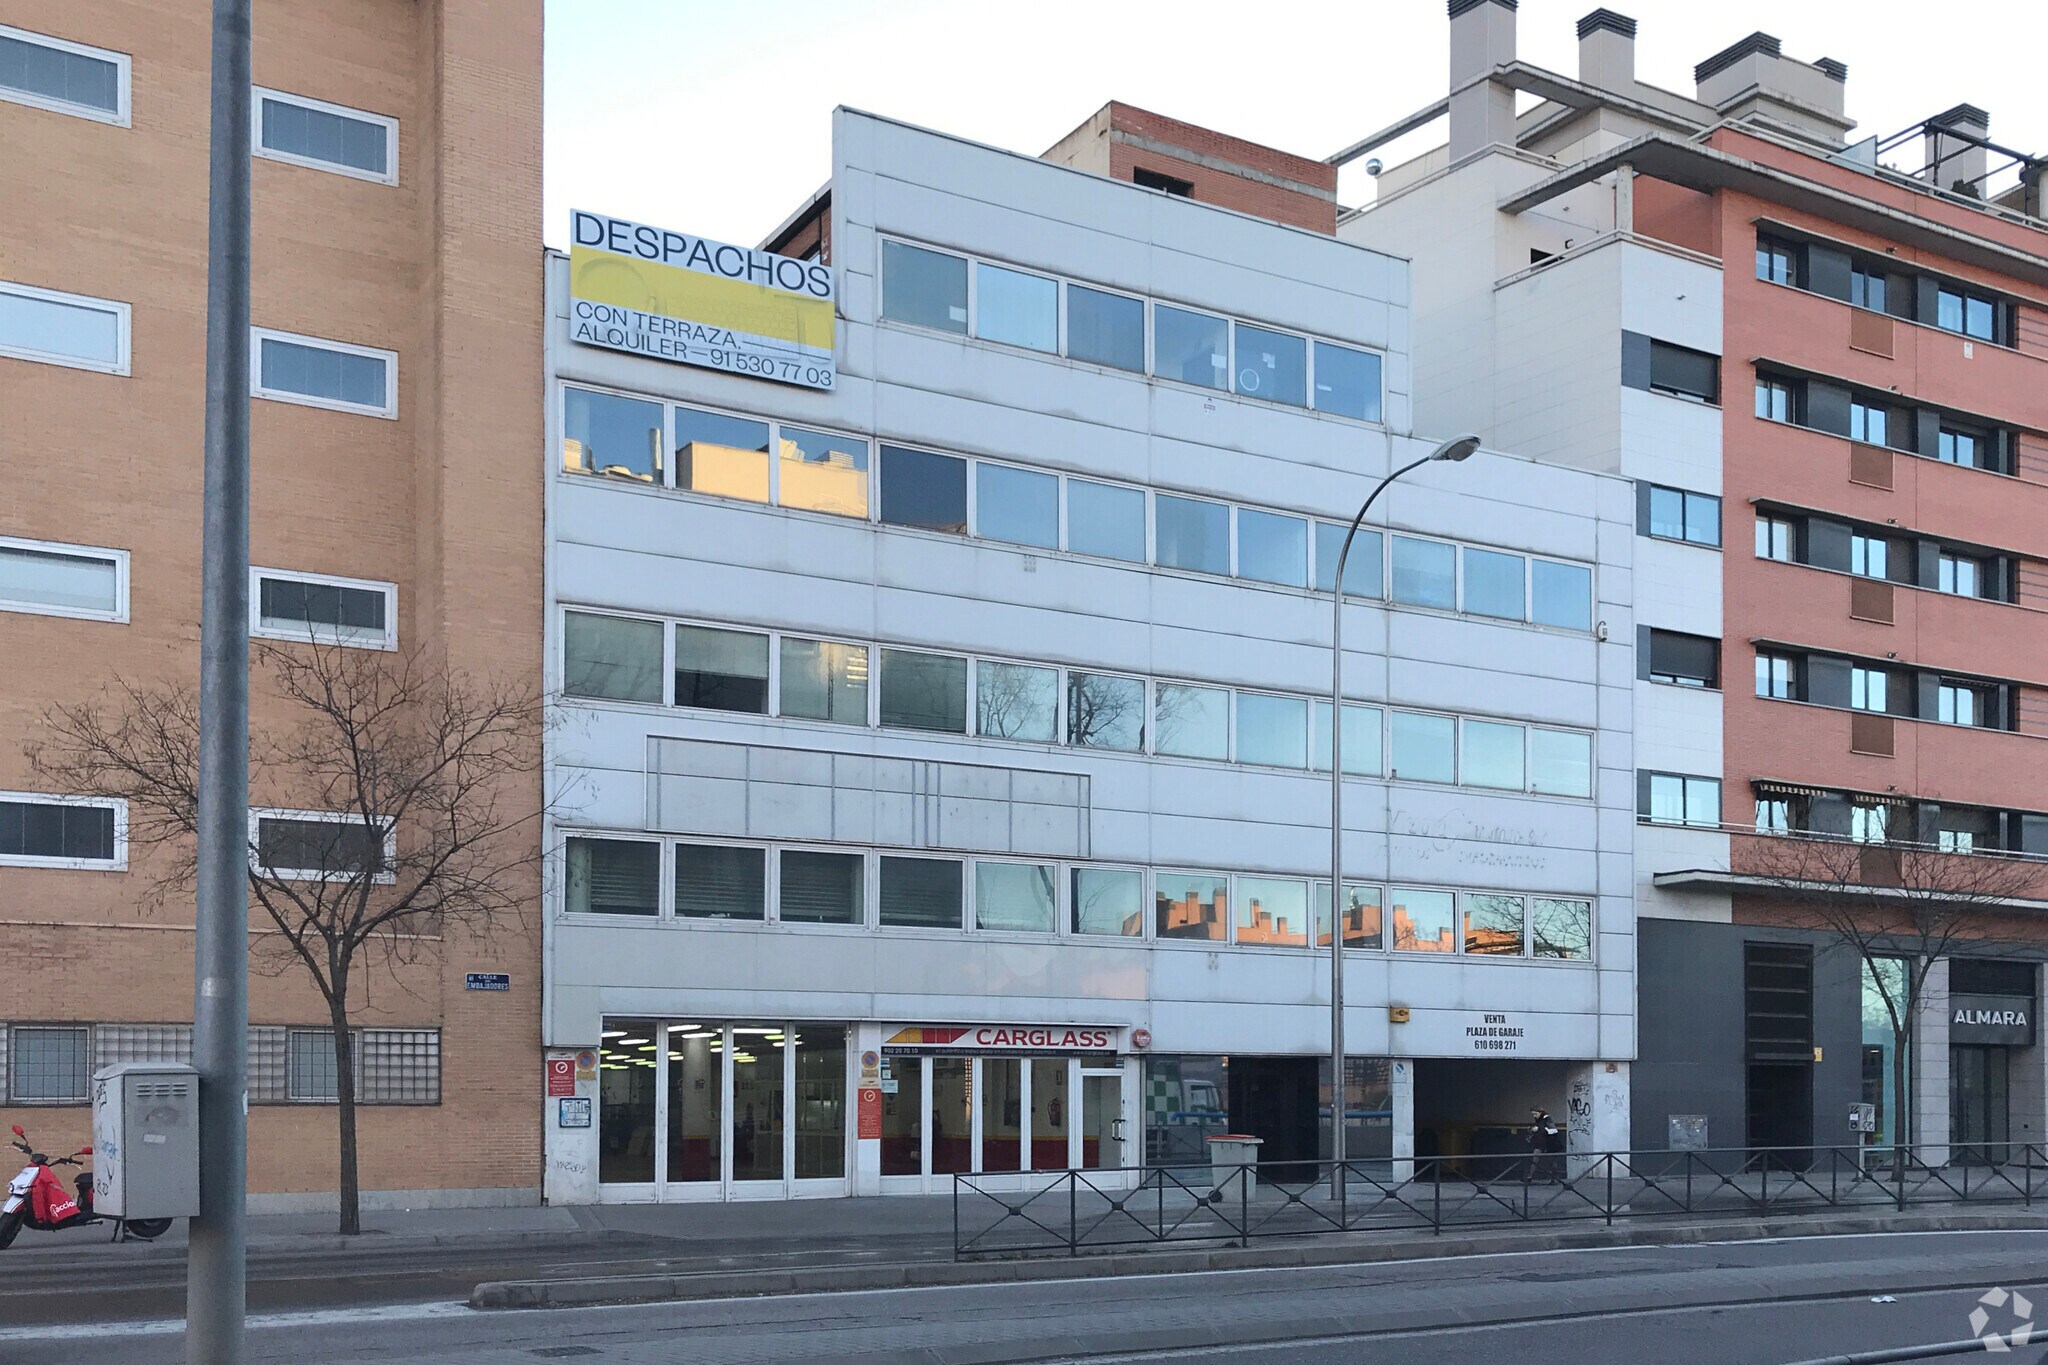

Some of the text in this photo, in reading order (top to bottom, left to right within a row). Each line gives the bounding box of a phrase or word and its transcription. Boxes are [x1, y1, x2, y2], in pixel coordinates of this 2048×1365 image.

[575, 212, 831, 297] DESPACHOS
[576, 301, 742, 350] CON TERRAZA.
[577, 323, 832, 387] ALQUILER 91 530 77 03
[467, 982, 509, 990] EMBAJADORES
[1484, 1014, 1506, 1024] VENTA
[1953, 1009, 2028, 1026] ALMARA
[976, 1028, 1108, 1048] CARGLASS
[1466, 1027, 1524, 1037] PLAZA DE GARAJE
[1474, 1040, 1517, 1050] 610 698 271
